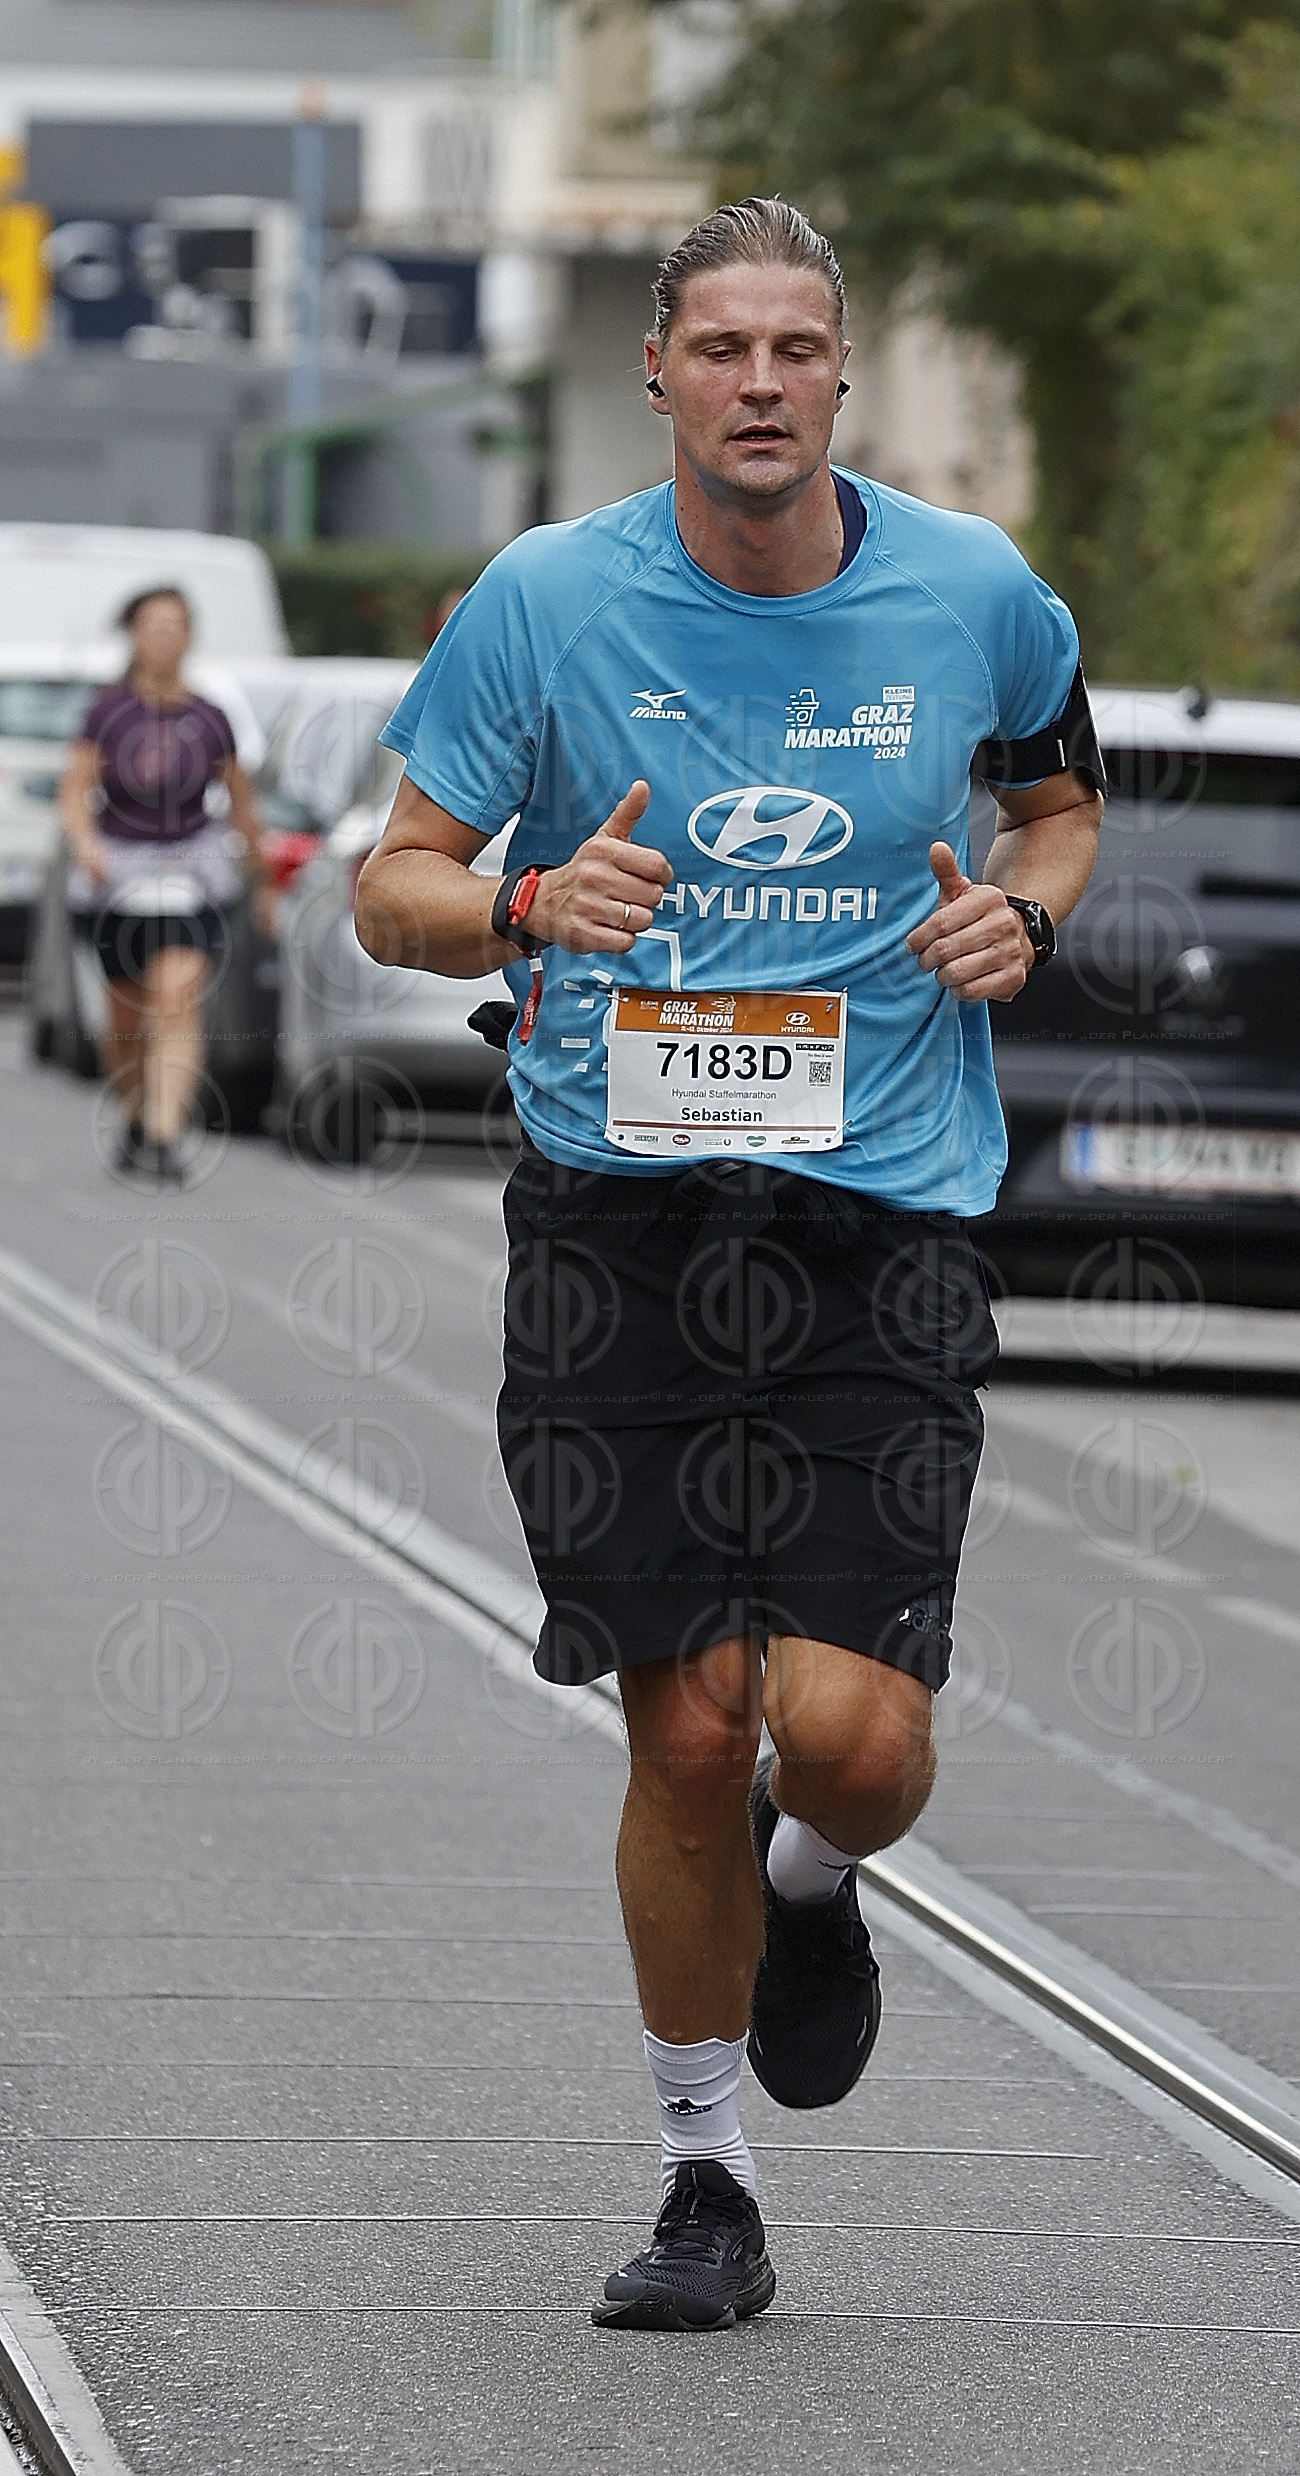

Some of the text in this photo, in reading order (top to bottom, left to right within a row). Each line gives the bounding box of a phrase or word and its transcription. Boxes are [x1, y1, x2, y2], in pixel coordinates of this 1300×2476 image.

[629, 706, 686, 720] MIZUNO
[852, 704, 915, 725] GRAZ
[784, 725, 912, 749] MARATHON
[873, 746, 906, 760] 2024
[656, 883, 877, 922] HYUNDAI
[662, 1000, 698, 1013] GRAZ
[659, 1012, 734, 1026] MARATHON
[657, 1042, 792, 1081] 7183D
[672, 1089, 777, 1100] Hyundai Staffelmarathon
[681, 1107, 763, 1122] Sebastian
